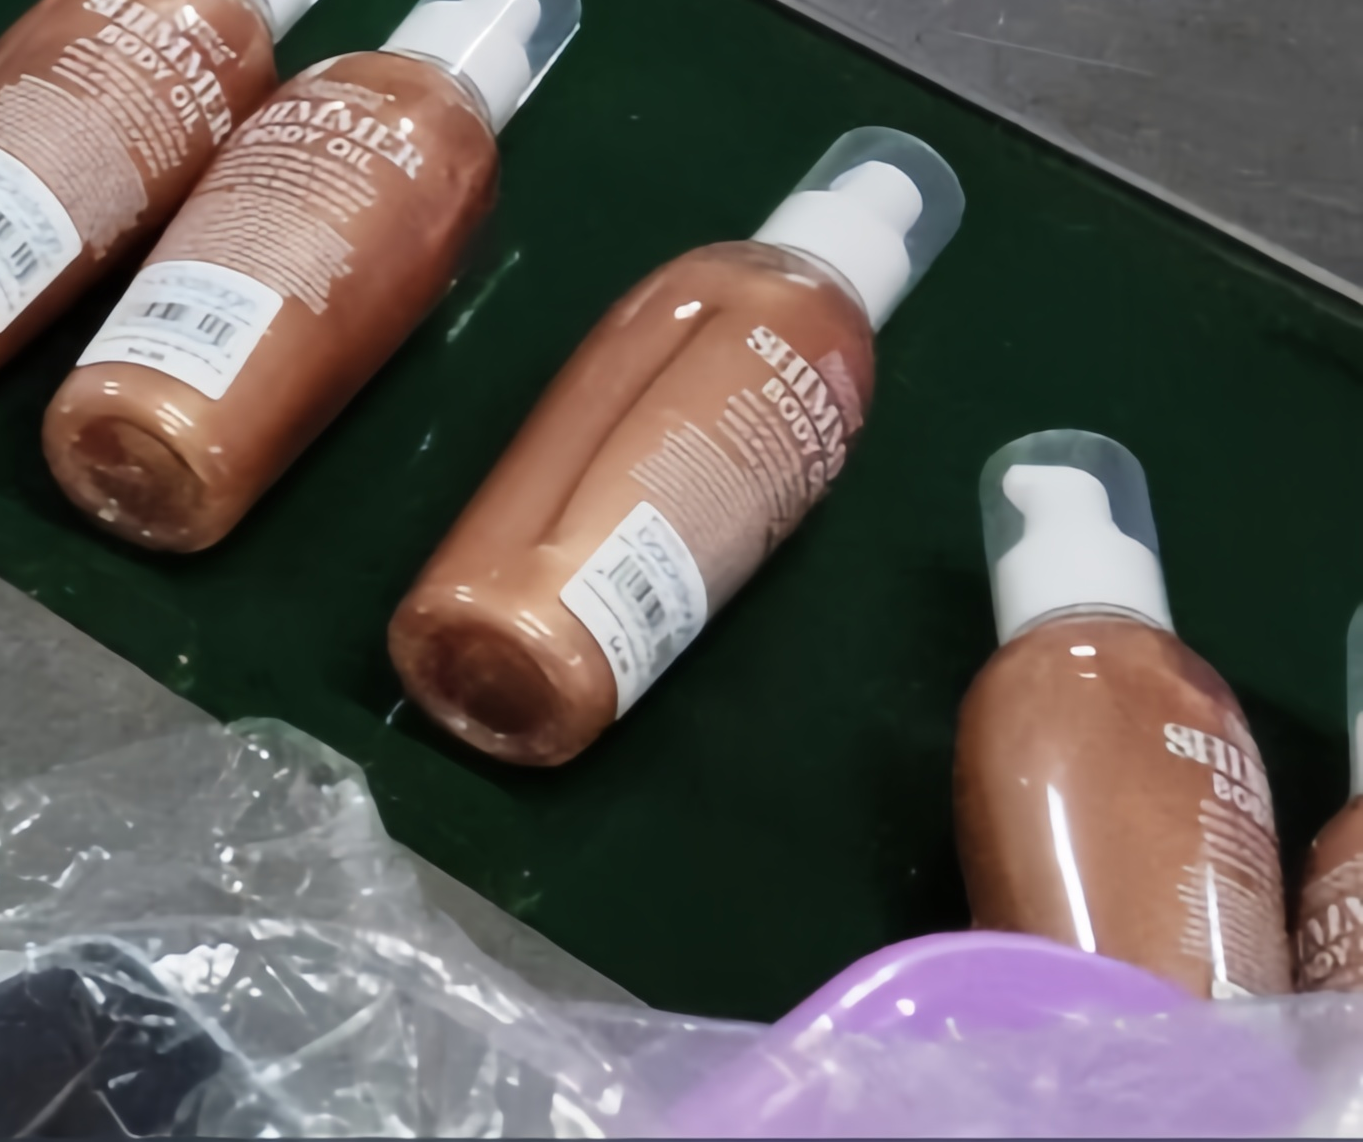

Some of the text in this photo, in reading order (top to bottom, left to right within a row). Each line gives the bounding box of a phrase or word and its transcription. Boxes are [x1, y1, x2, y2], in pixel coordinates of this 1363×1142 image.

[96, 23, 201, 135] BODY OIL
[326, 137, 372, 175] OIL
[761, 377, 823, 456] BODY
